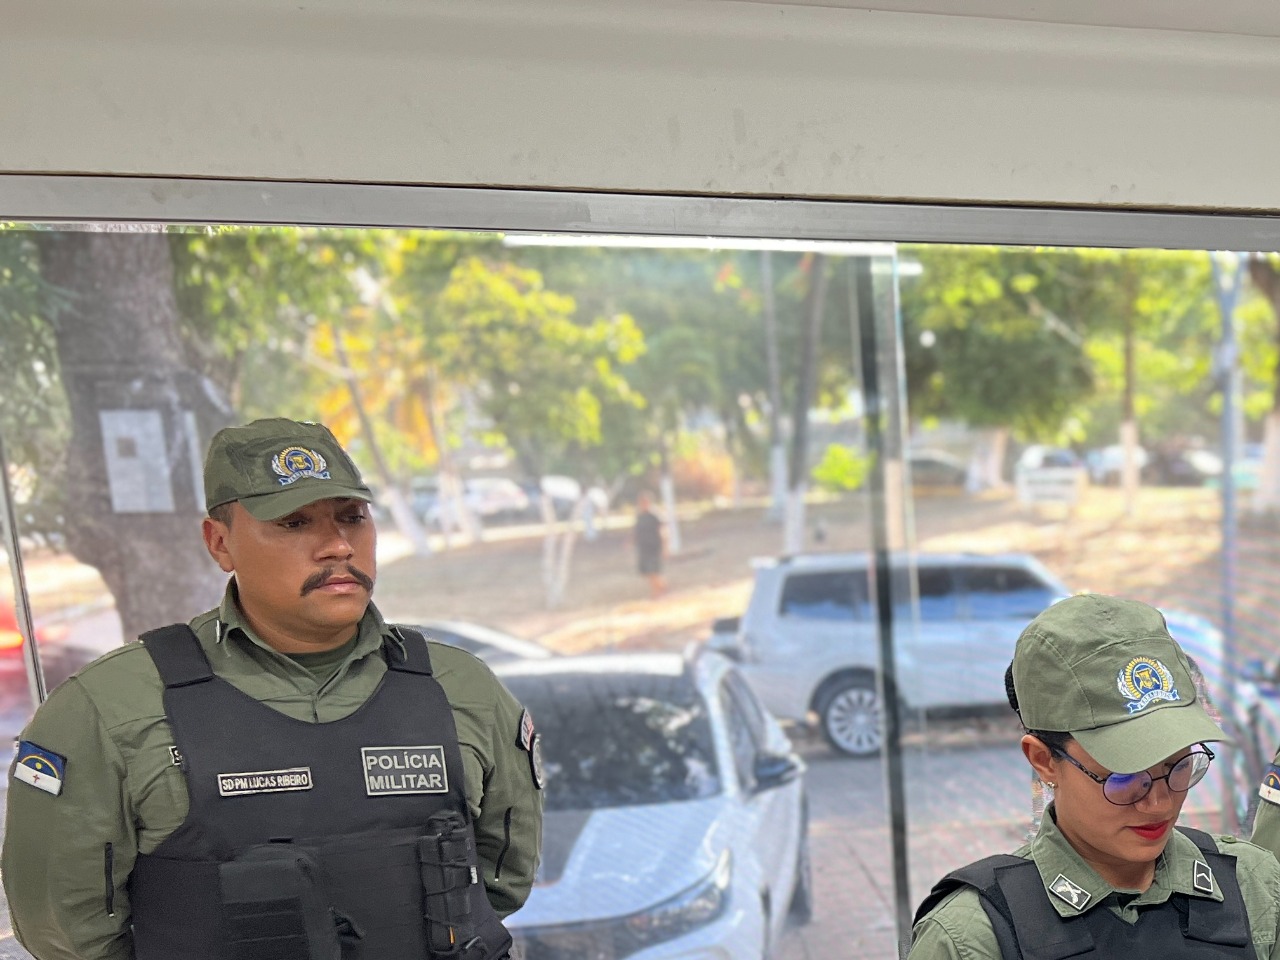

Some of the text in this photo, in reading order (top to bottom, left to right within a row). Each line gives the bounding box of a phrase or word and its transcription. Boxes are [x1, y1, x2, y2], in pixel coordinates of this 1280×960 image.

[366, 751, 441, 770] POLÍCIA
[222, 774, 308, 790] SD PM LUCAS RIBEIRO
[369, 774, 442, 790] MILITAR
